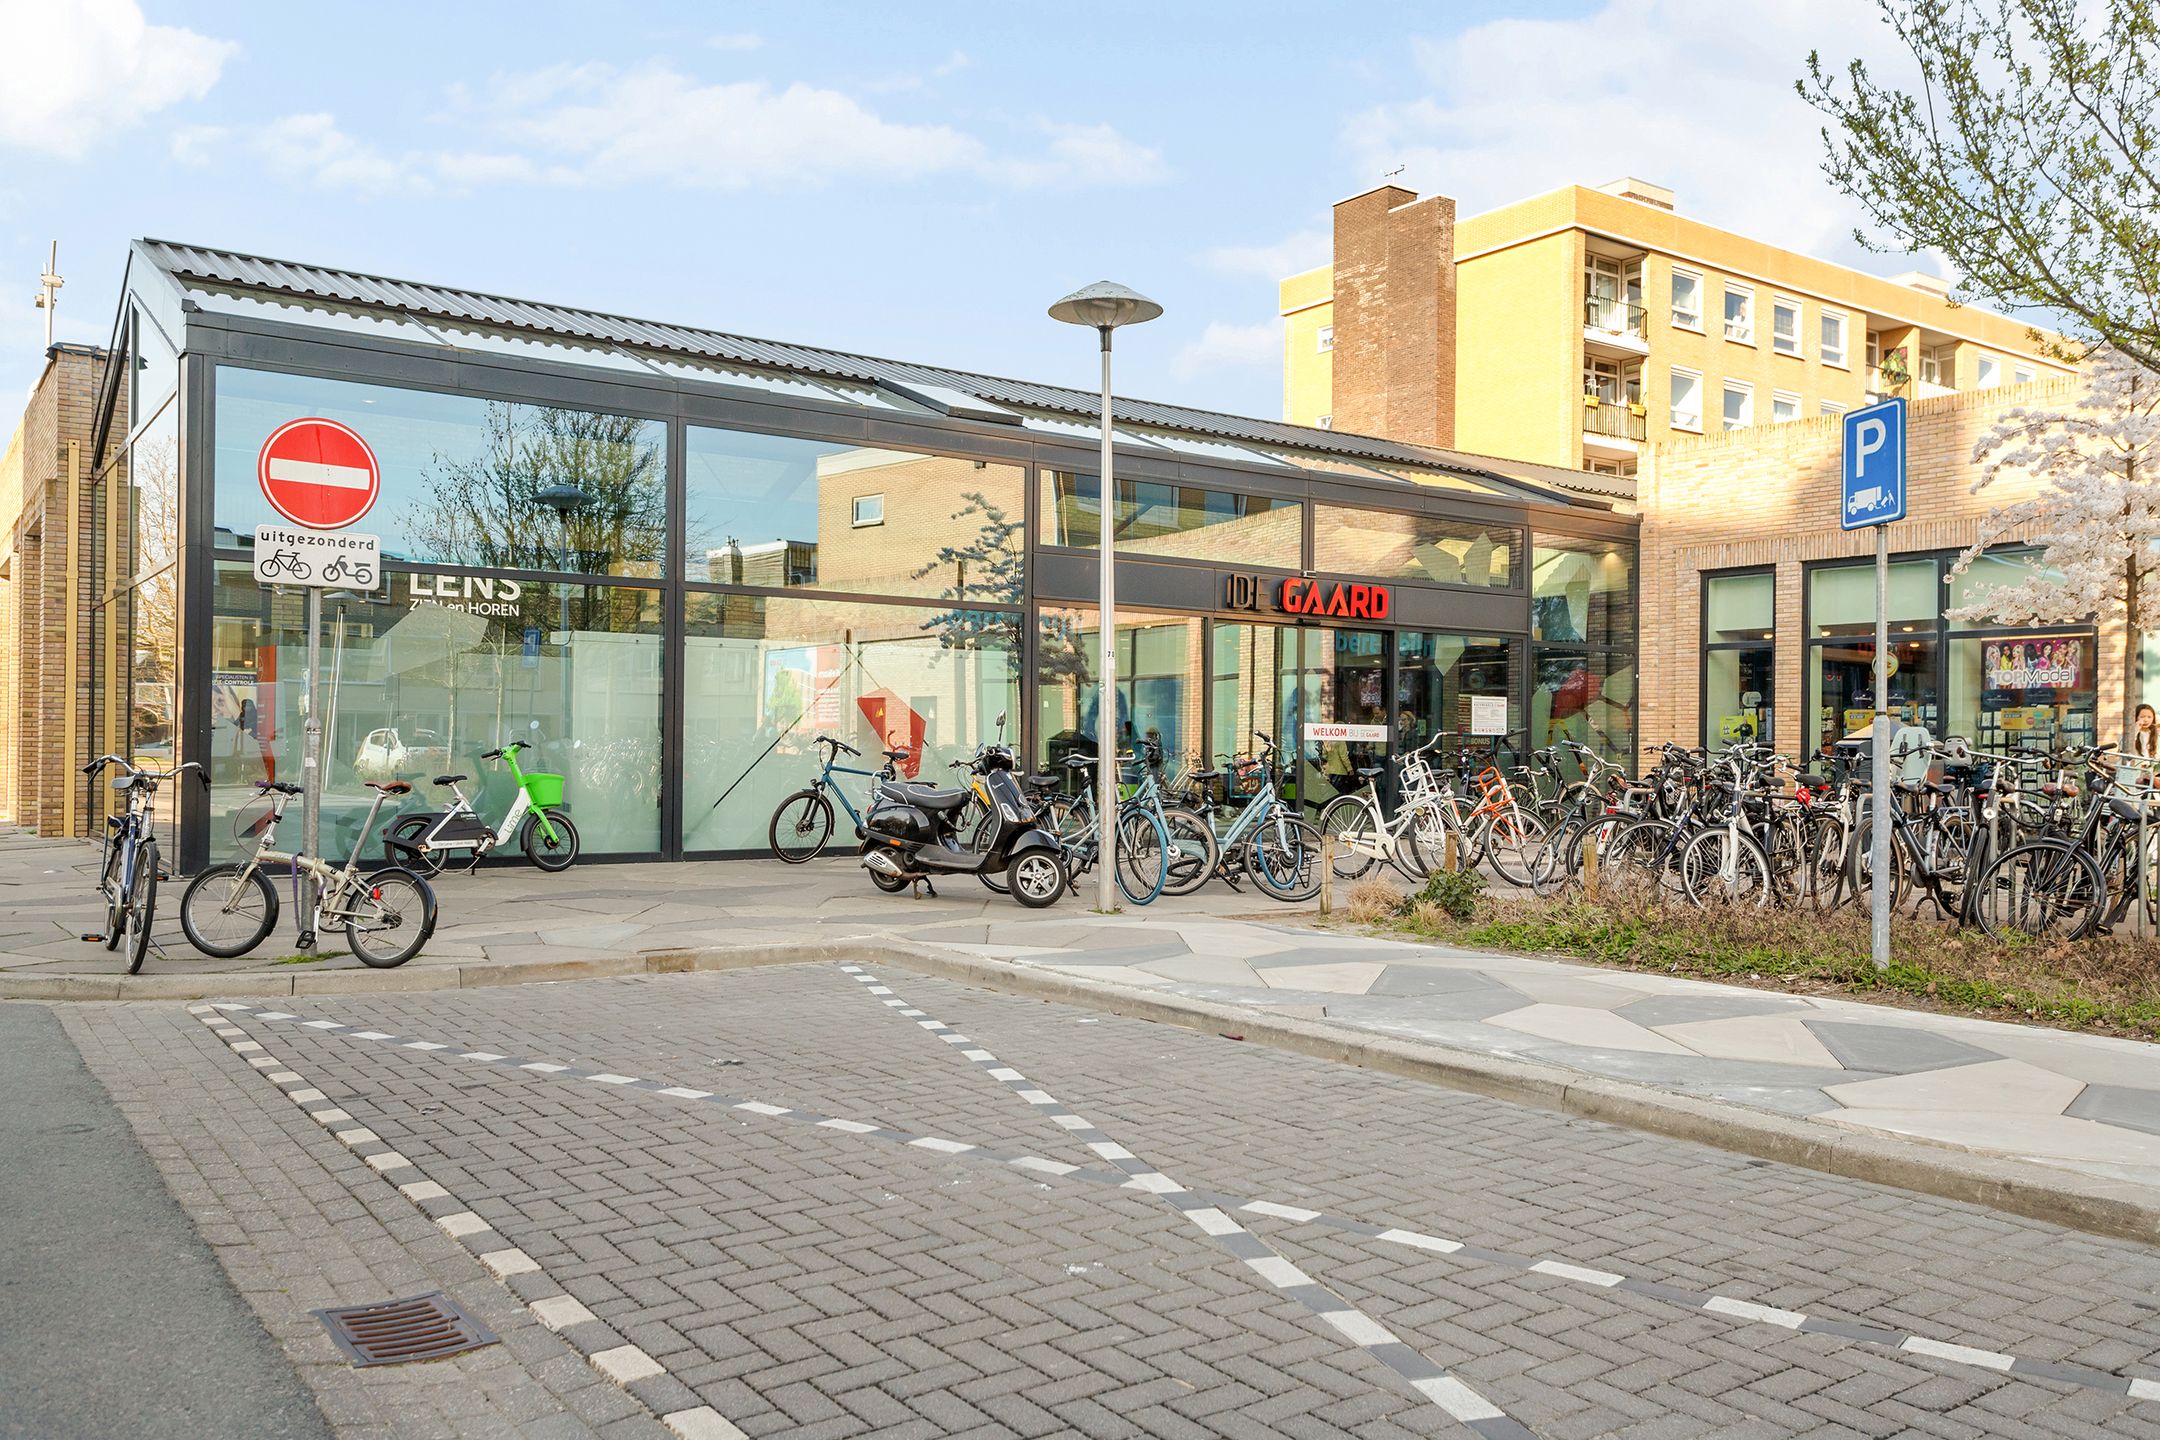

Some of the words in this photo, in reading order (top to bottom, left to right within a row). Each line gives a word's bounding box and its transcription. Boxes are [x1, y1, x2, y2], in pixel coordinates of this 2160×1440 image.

[1856, 418, 1887, 478] P
[261, 531, 374, 550] uitgezonderd
[410, 561, 521, 600] LENS
[469, 602, 520, 617] HOREN
[1282, 578, 1389, 619] GAARD
[1312, 728, 1347, 737] WELKOM
[504, 809, 521, 834] Lime
